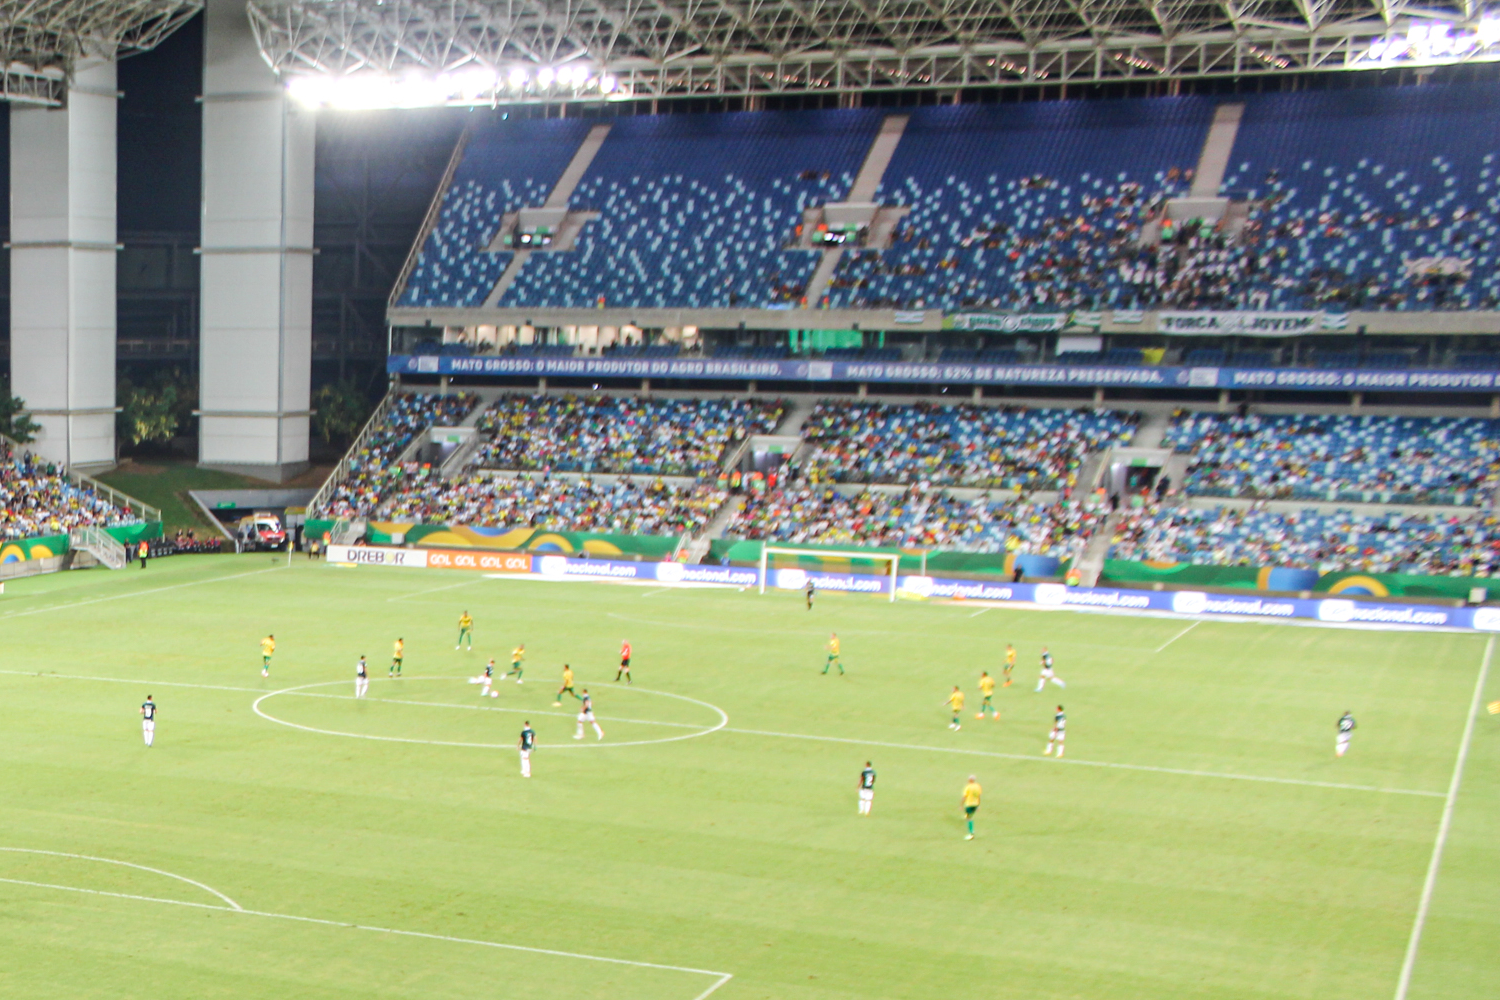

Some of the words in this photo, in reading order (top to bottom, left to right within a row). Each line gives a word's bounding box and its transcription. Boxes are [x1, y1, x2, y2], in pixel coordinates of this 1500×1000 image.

[452, 358, 483, 371] MATO
[536, 359, 544, 372] O
[547, 359, 584, 372] MAIOR
[587, 360, 649, 374] PRODUTOR
[652, 361, 668, 373] DO
[670, 361, 703, 374] AGRO
[846, 365, 883, 378] MATO
[974, 367, 993, 380] DE
[994, 367, 1067, 382] NATUREZA
[1234, 371, 1275, 385] MATO
[1342, 372, 1355, 386] O
[1355, 372, 1407, 387] MAIOR
[1408, 373, 1492, 387] PRODUTOR
[430, 554, 452, 566] GOL
[455, 555, 477, 567] GOL
[480, 556, 502, 569] GOL
[506, 557, 528, 570] GOL
